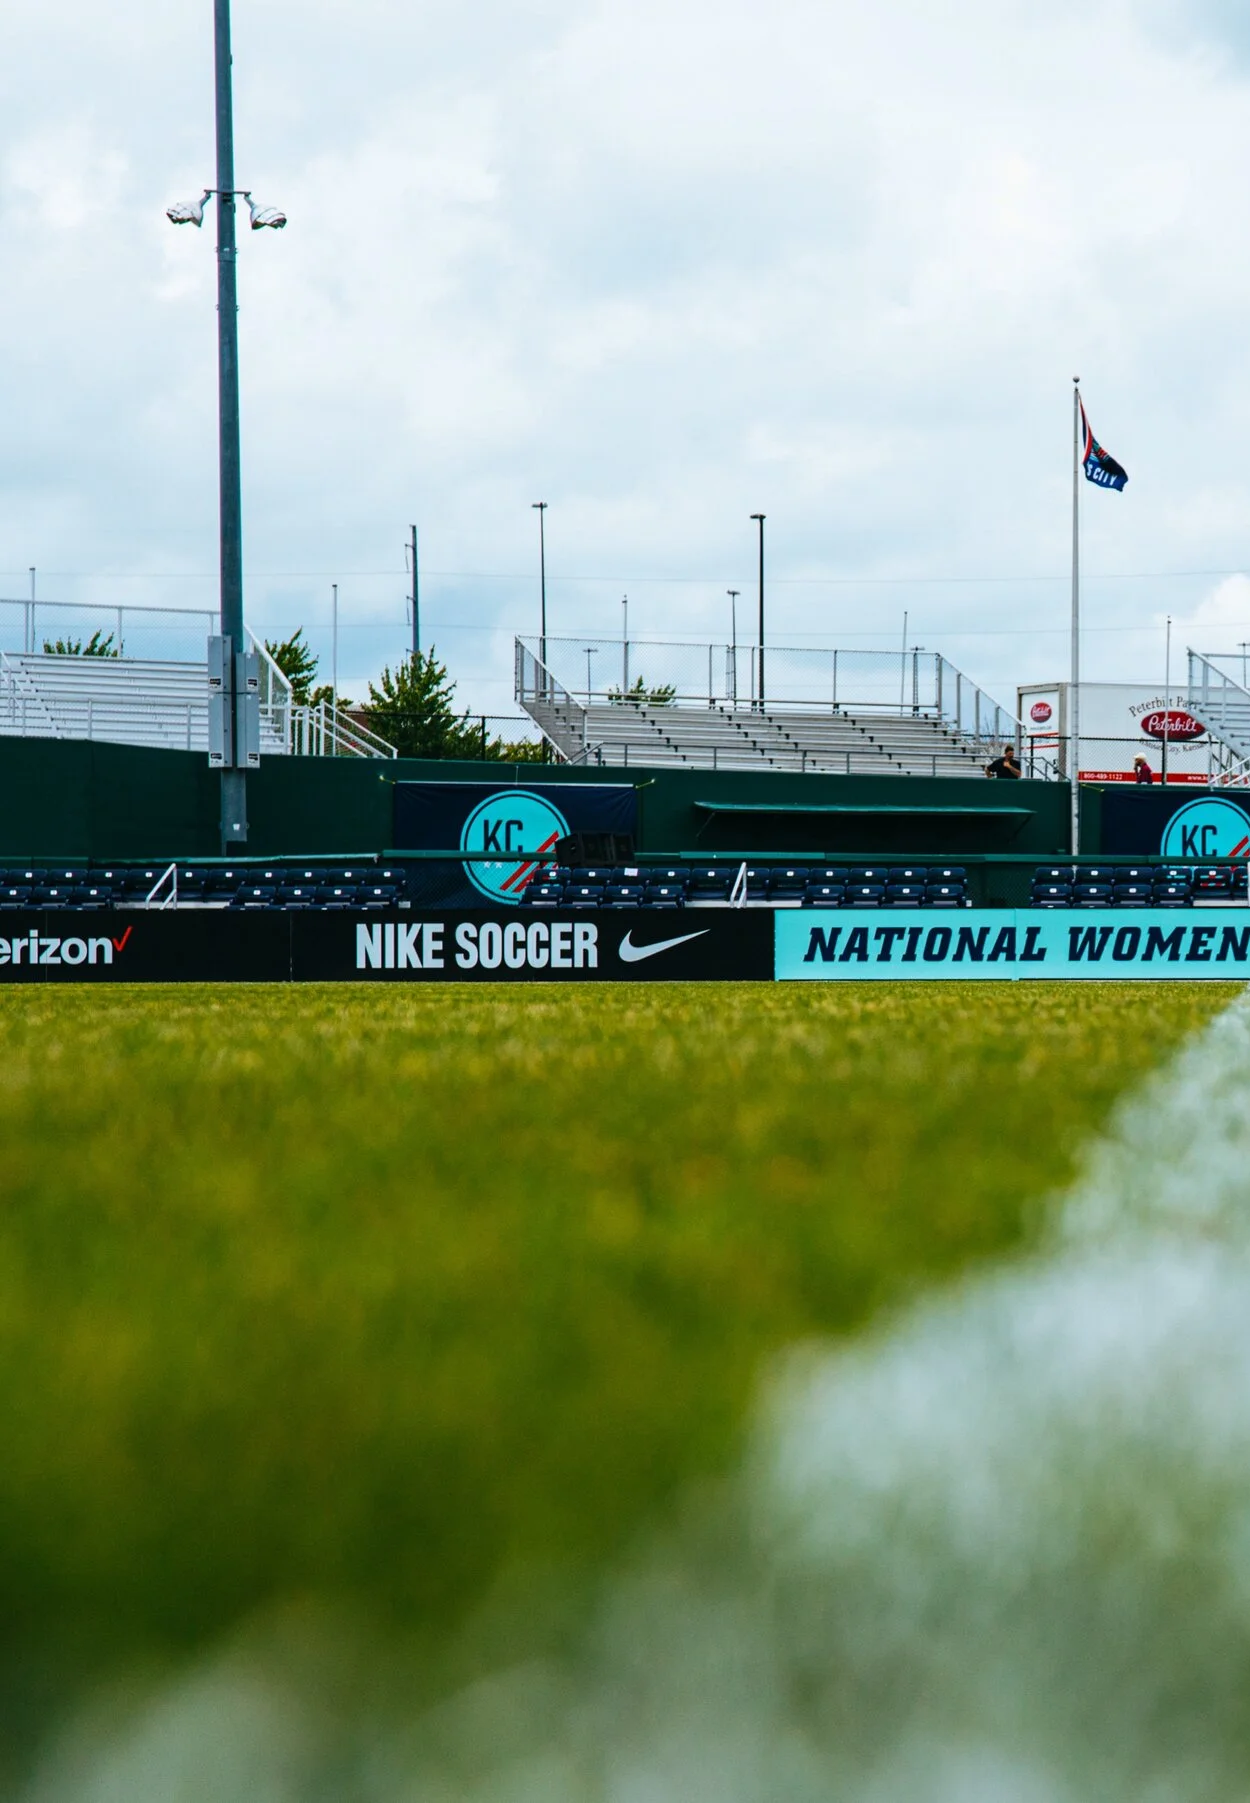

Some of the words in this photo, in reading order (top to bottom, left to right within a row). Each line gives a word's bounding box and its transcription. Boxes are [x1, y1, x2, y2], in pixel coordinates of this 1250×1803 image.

[1128, 696, 1173, 717] Peterbit
[1148, 715, 1197, 732] Peterbilt
[483, 819, 523, 852] KC
[1181, 824, 1218, 857] KC
[356, 924, 445, 969] NIKE
[455, 922, 598, 969] SOCCER
[803, 927, 1047, 962] NATIONAL
